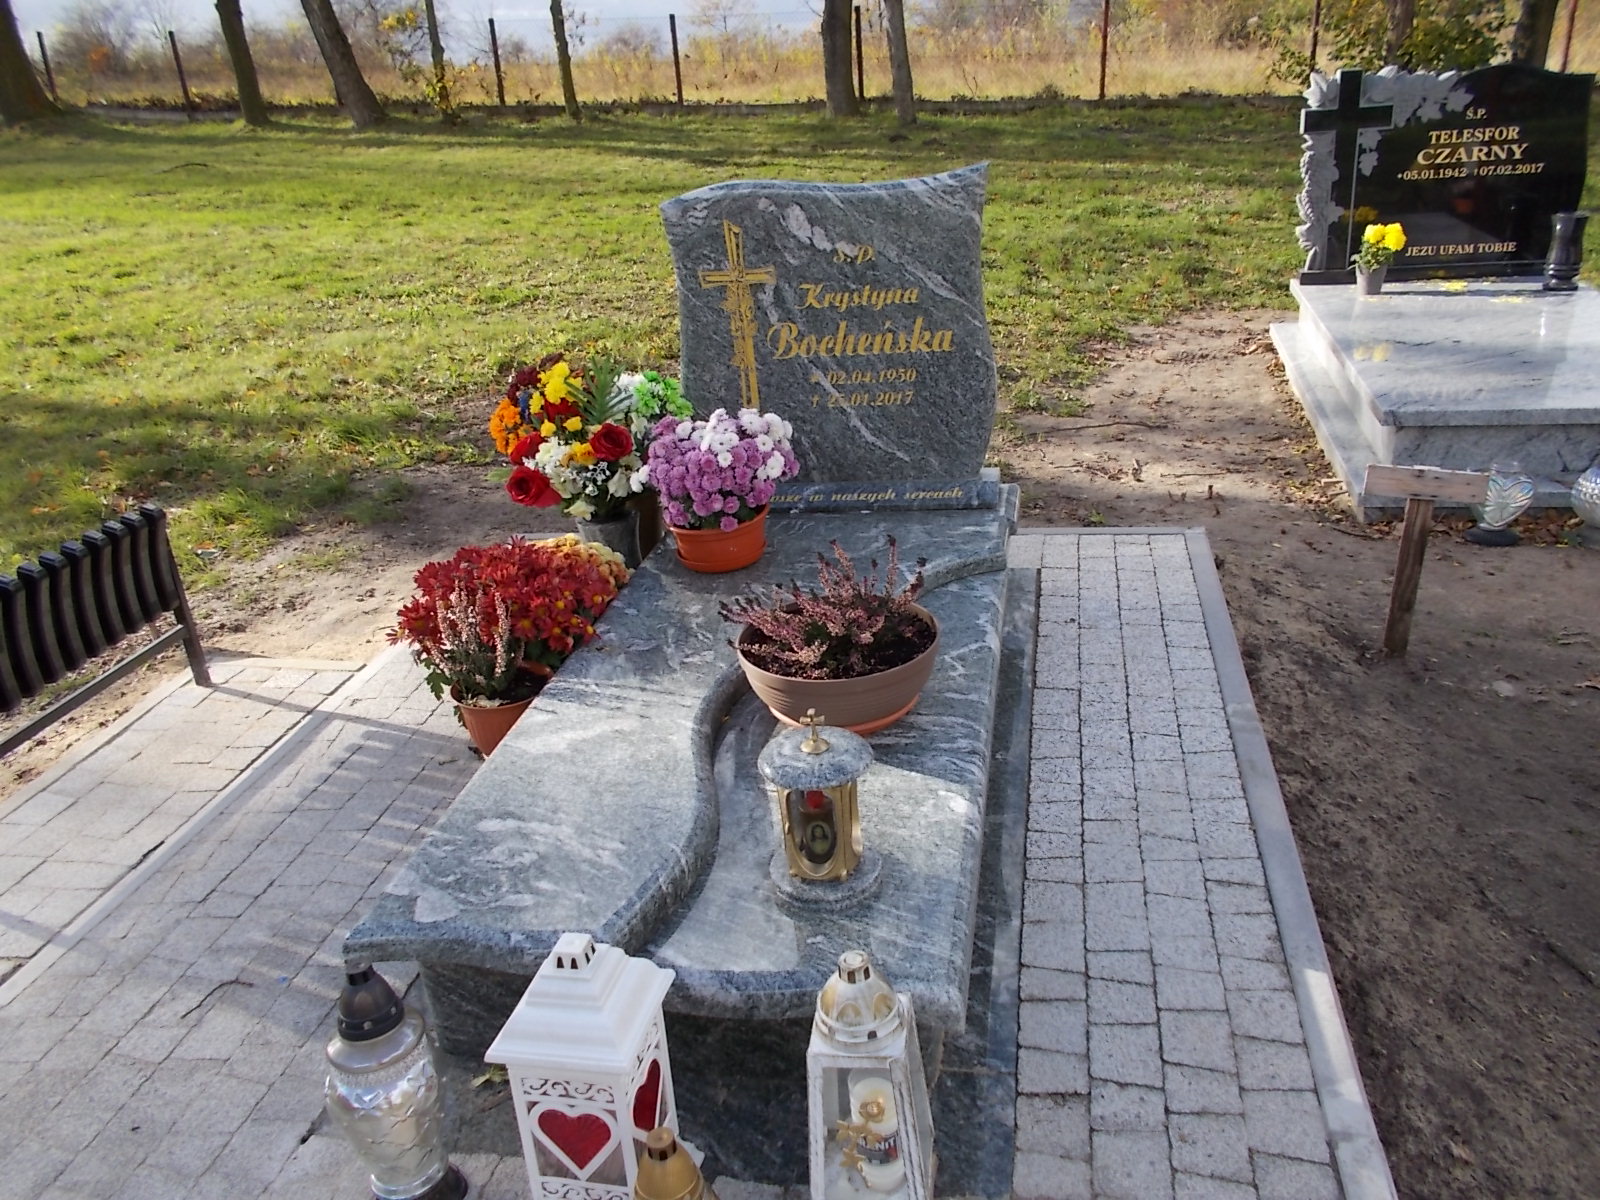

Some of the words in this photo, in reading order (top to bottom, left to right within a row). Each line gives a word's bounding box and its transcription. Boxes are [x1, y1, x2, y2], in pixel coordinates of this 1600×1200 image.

[1428, 126, 1520, 145] TELESFOR
[1416, 143, 1529, 165] CZARNY
[1405, 245, 1437, 257] JEZU
[1441, 244, 1474, 256] UFAM
[1477, 242, 1517, 253] TOBIE
[795, 283, 919, 312] Krystyna
[767, 317, 956, 360] Bocheńska
